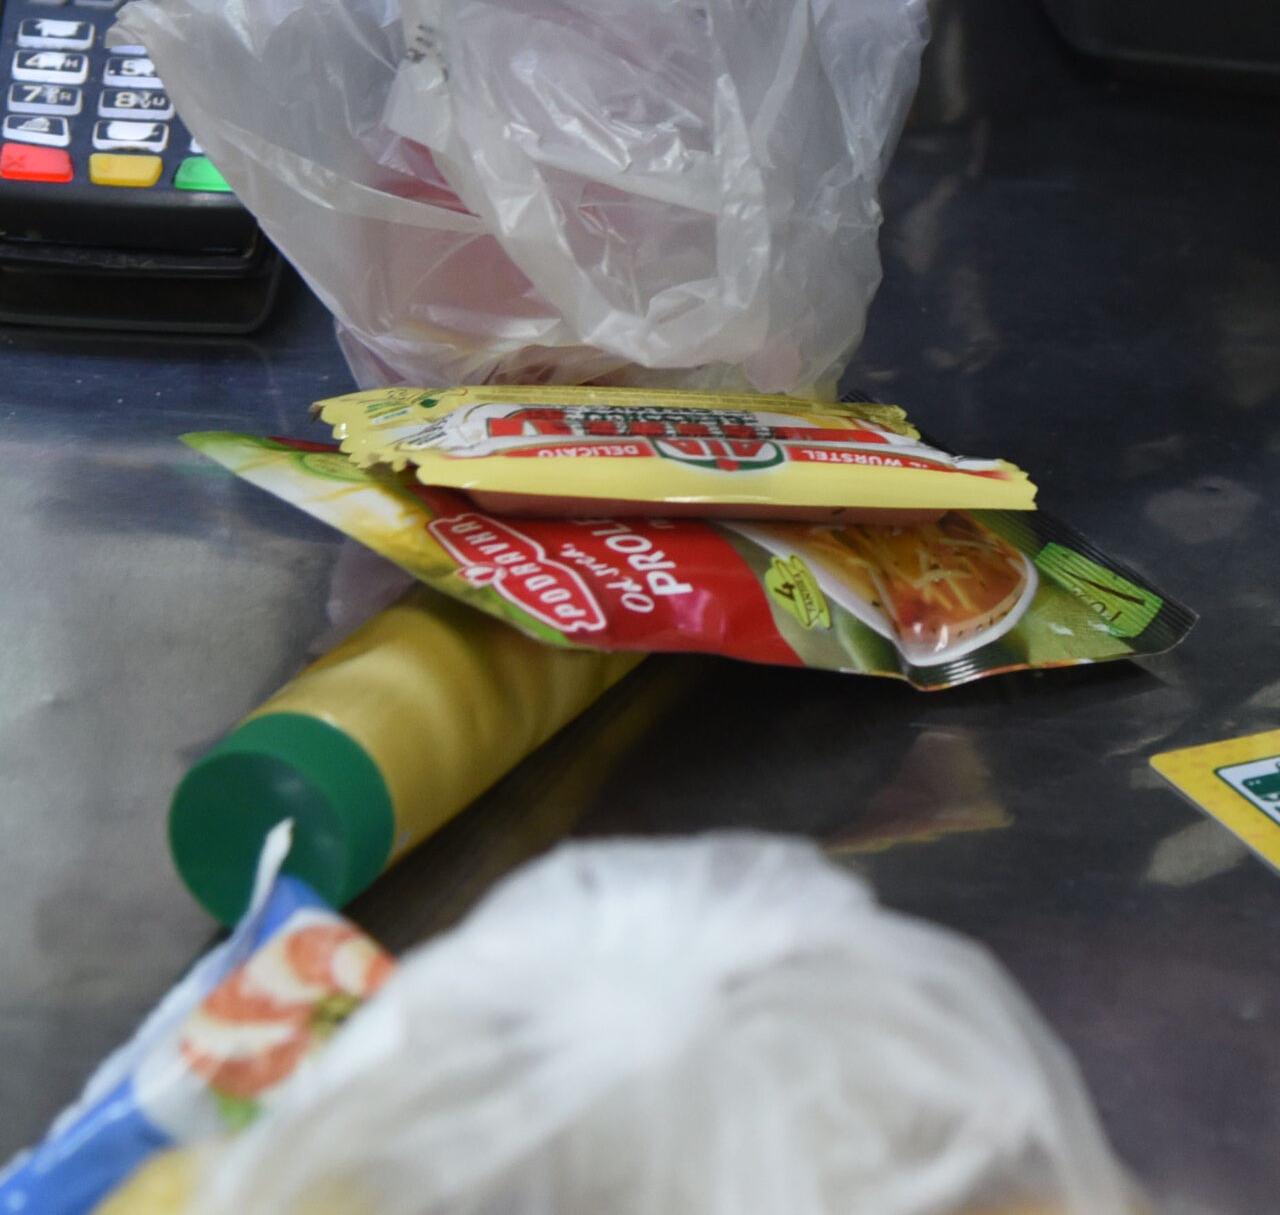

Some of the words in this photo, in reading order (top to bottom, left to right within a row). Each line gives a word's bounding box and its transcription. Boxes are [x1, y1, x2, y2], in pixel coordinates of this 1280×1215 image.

[537, 444, 640, 458] DELICATO
[802, 449, 904, 467] WURSTEL
[451, 520, 587, 619] PODRAVKA
[774, 581, 796, 602] 4
